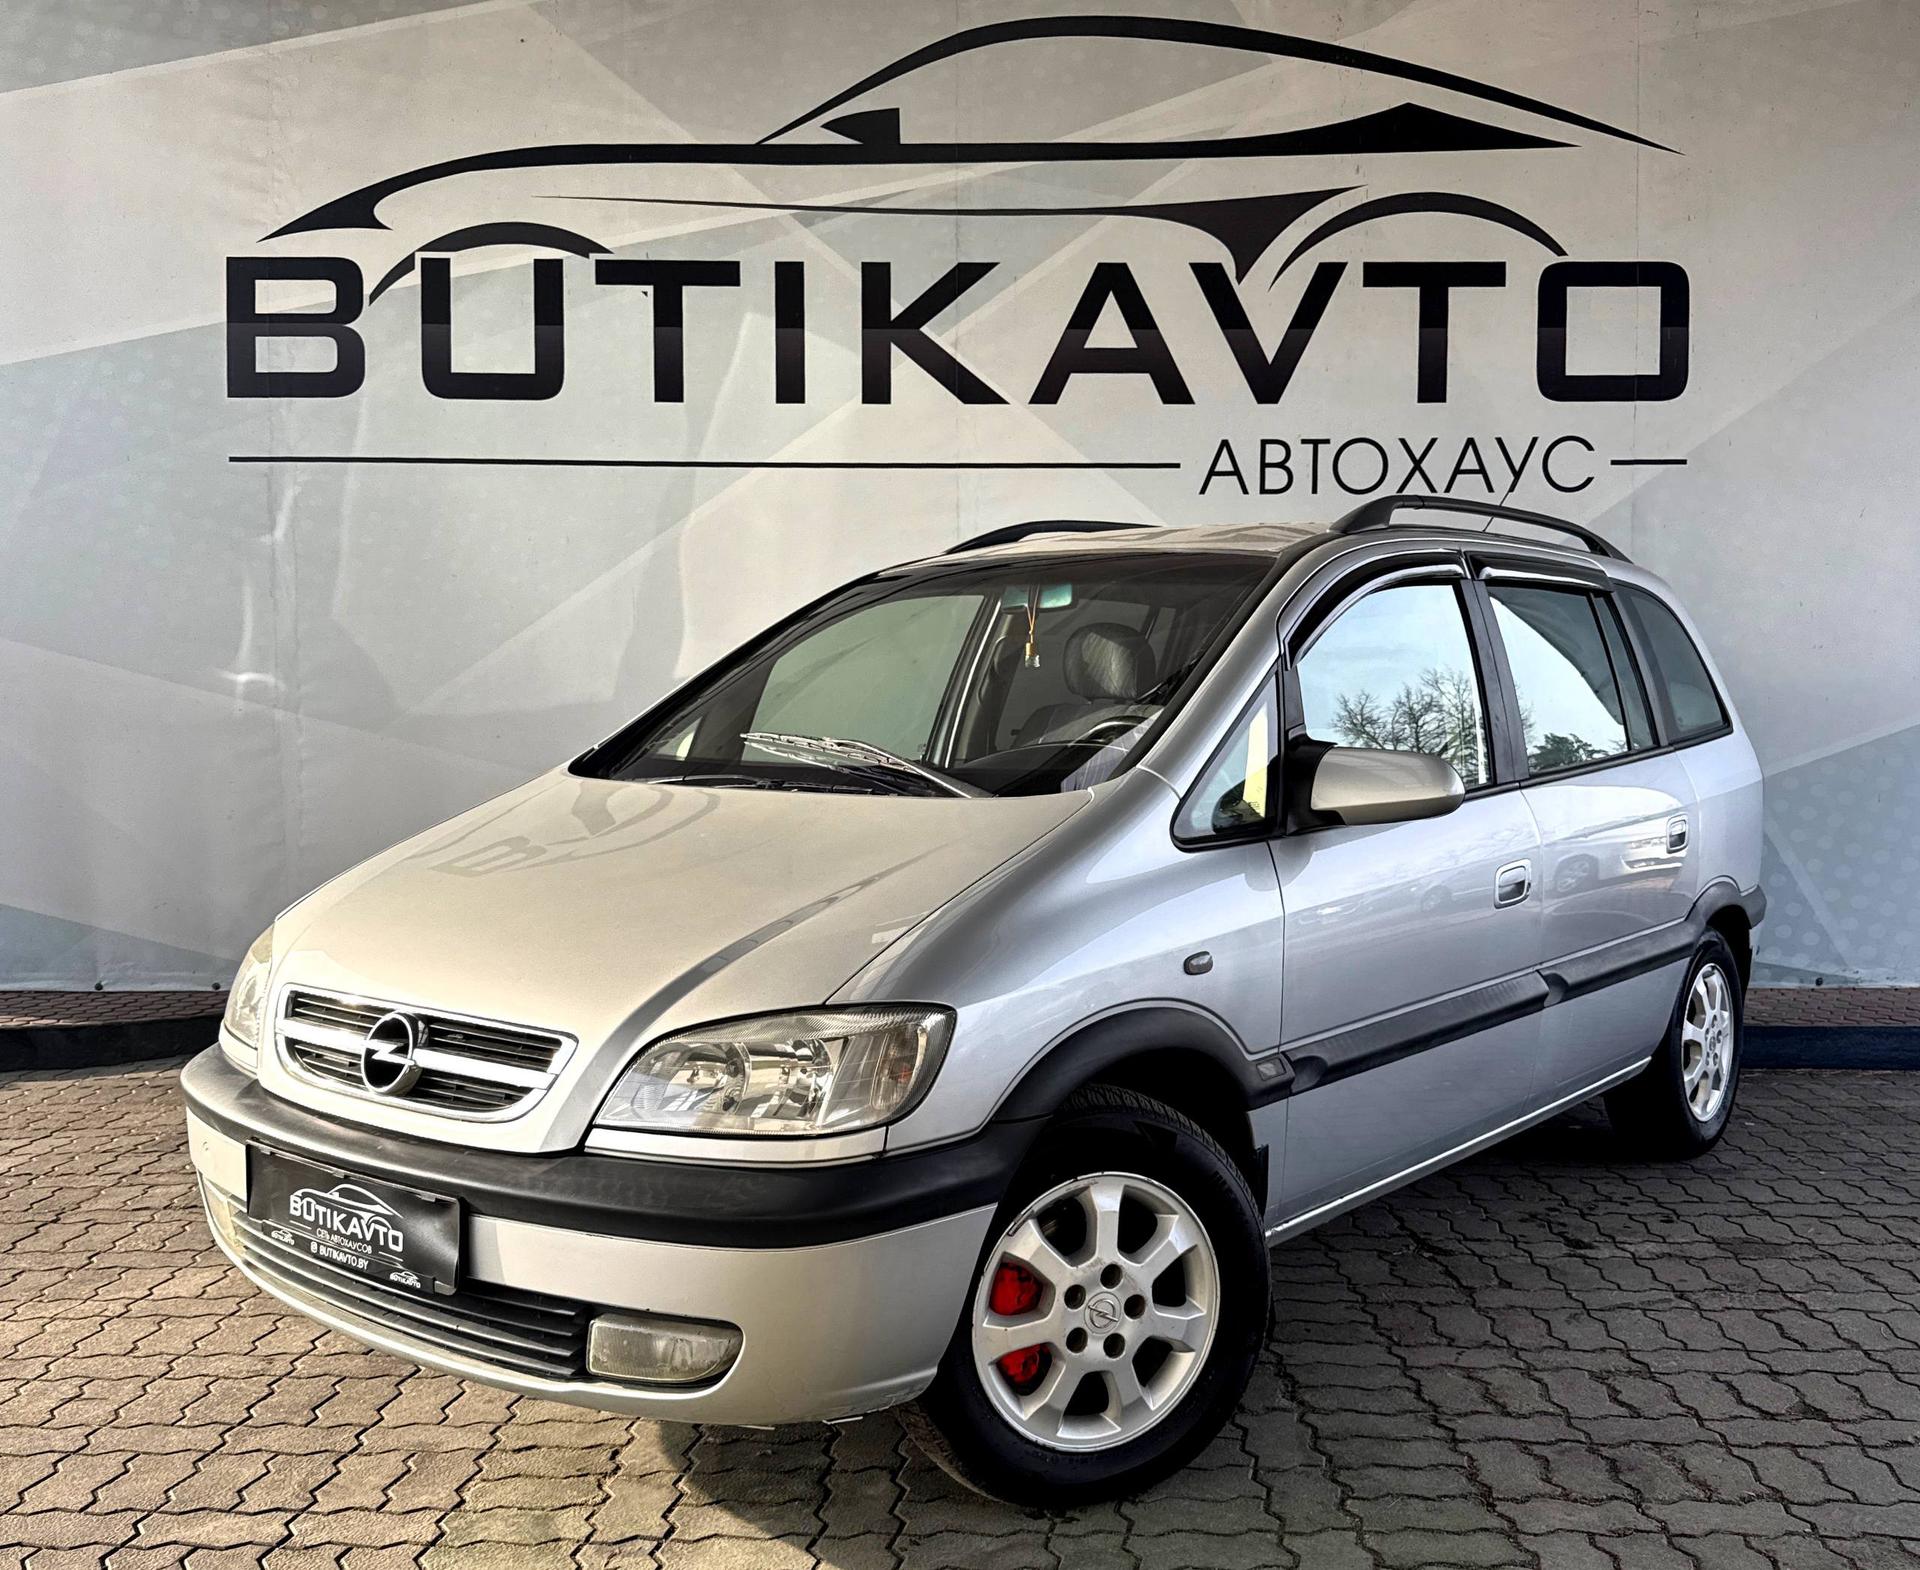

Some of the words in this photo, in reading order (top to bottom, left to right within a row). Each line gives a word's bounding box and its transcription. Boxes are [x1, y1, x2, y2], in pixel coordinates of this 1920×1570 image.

[226, 256, 1690, 405] BUTIKAVTO
[1199, 436, 1595, 495] АВТОХАУС
[289, 1195, 404, 1252] BUTIKAVTO
[330, 1234, 372, 1254] АВТОХАУСОВ
